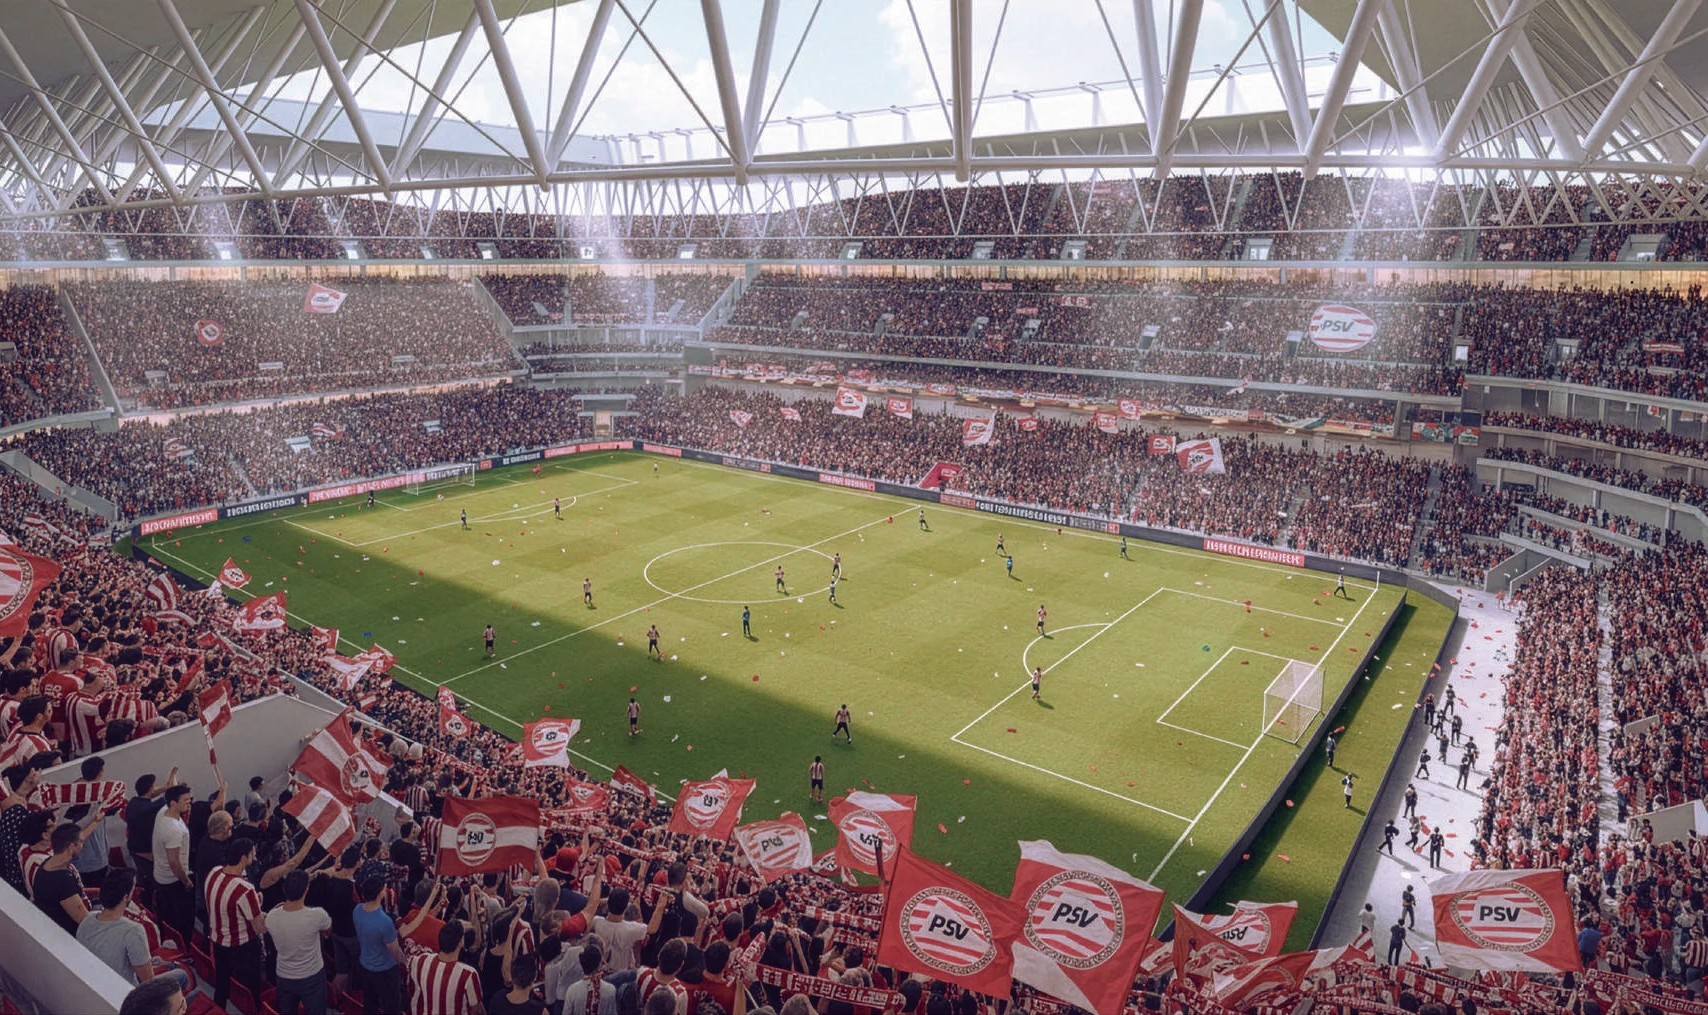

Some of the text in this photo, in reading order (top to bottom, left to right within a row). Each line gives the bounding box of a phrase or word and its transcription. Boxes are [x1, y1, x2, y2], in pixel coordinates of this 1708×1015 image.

[1321, 320, 1354, 332] PSV
[1052, 902, 1098, 928] PSV
[1479, 905, 1521, 922] PSV
[928, 913, 970, 941] PSV
